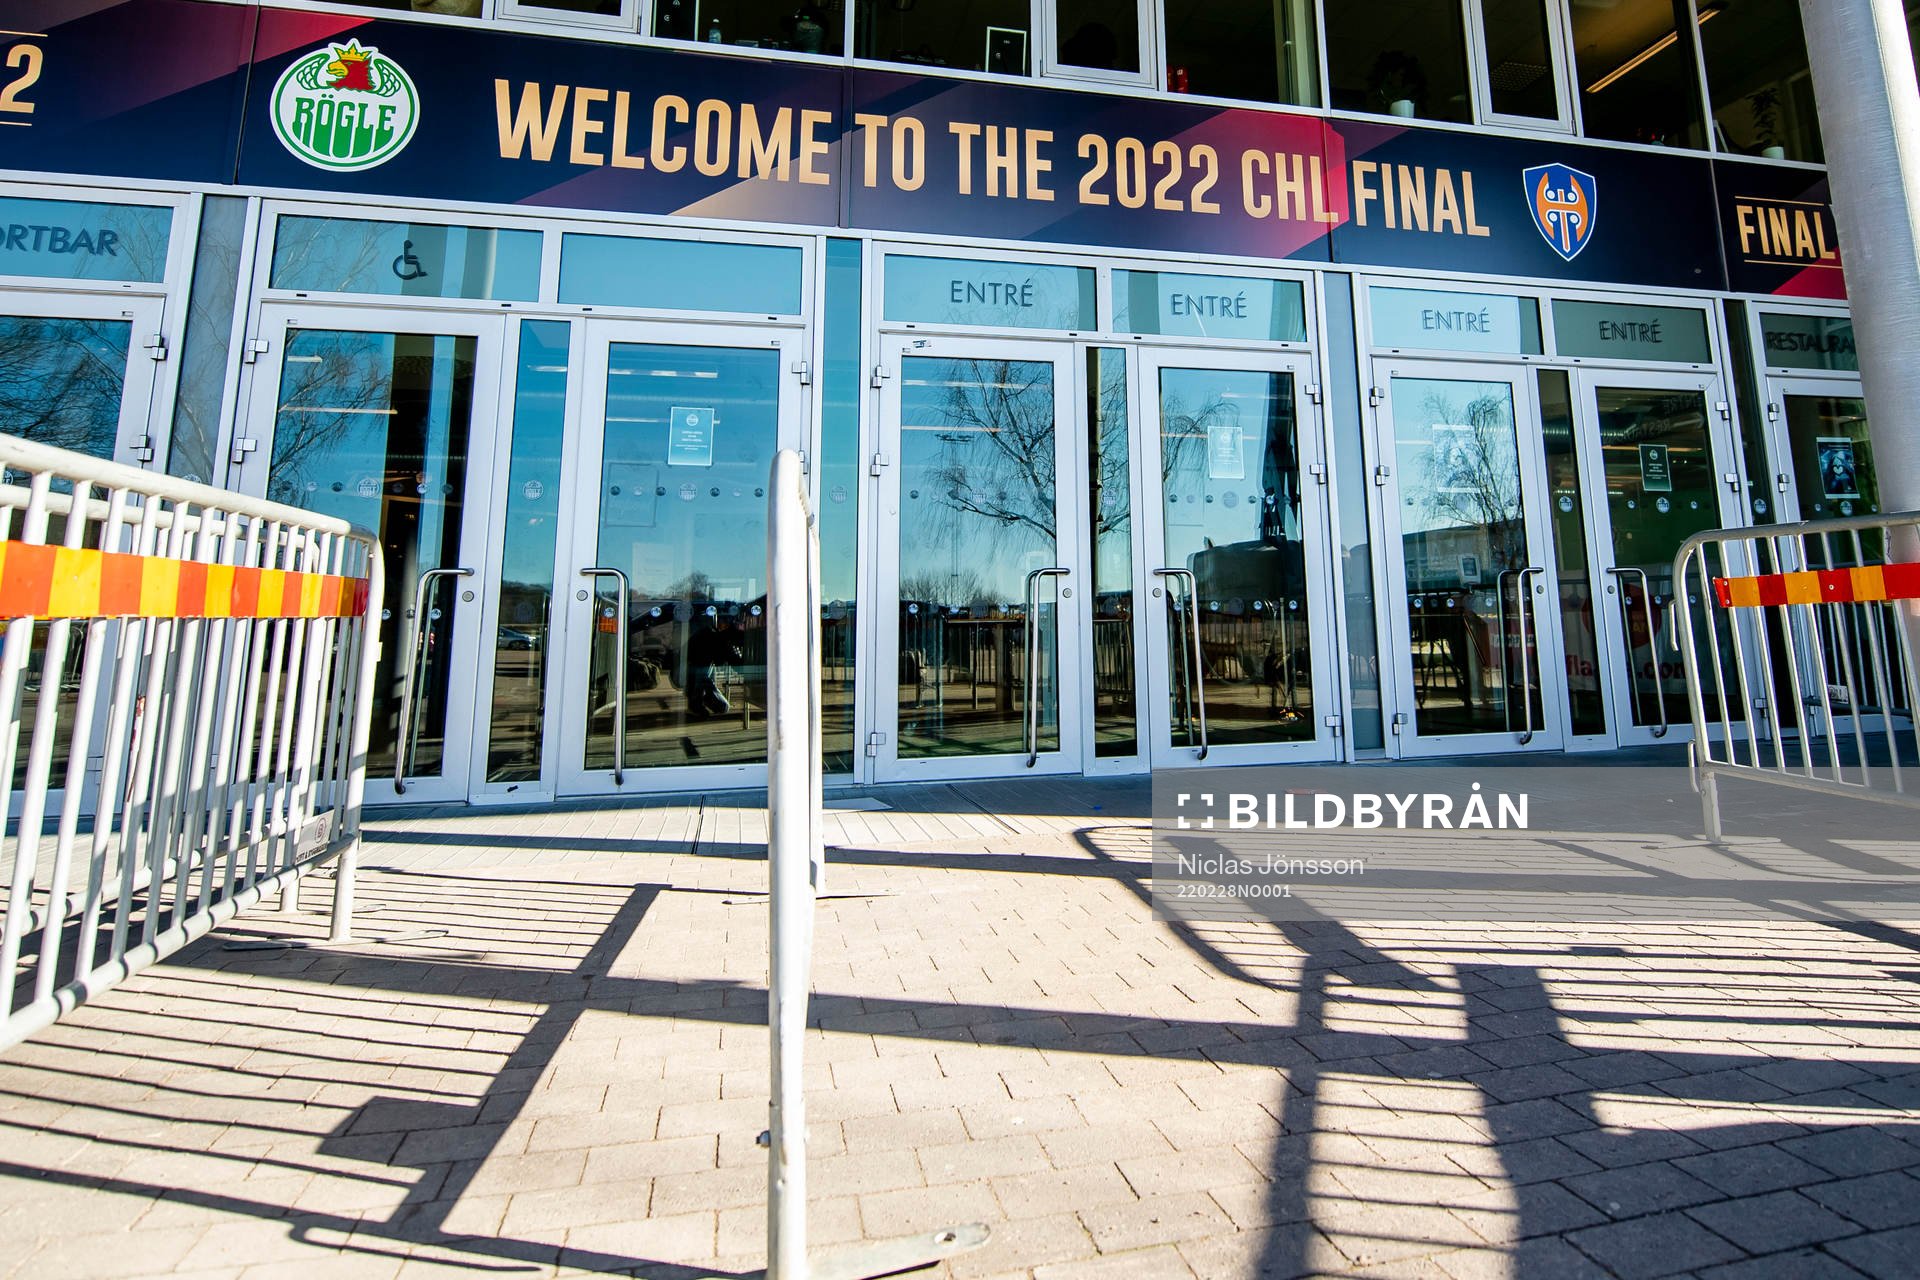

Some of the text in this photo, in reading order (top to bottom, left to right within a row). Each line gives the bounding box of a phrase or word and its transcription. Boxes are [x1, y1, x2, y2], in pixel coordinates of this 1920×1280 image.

[292, 93, 397, 158] RÖGLE
[495, 79, 1490, 236] WELCOME TO THE 2022 CHL FINAL
[0, 224, 119, 257] RTBAR
[1736, 205, 1836, 259] FINAL
[951, 278, 1033, 307] ENTRÉ
[1171, 291, 1247, 318] ENTRÉ
[1422, 307, 1490, 333] ENTRÉ
[1599, 318, 1663, 343] ENTRÉ
